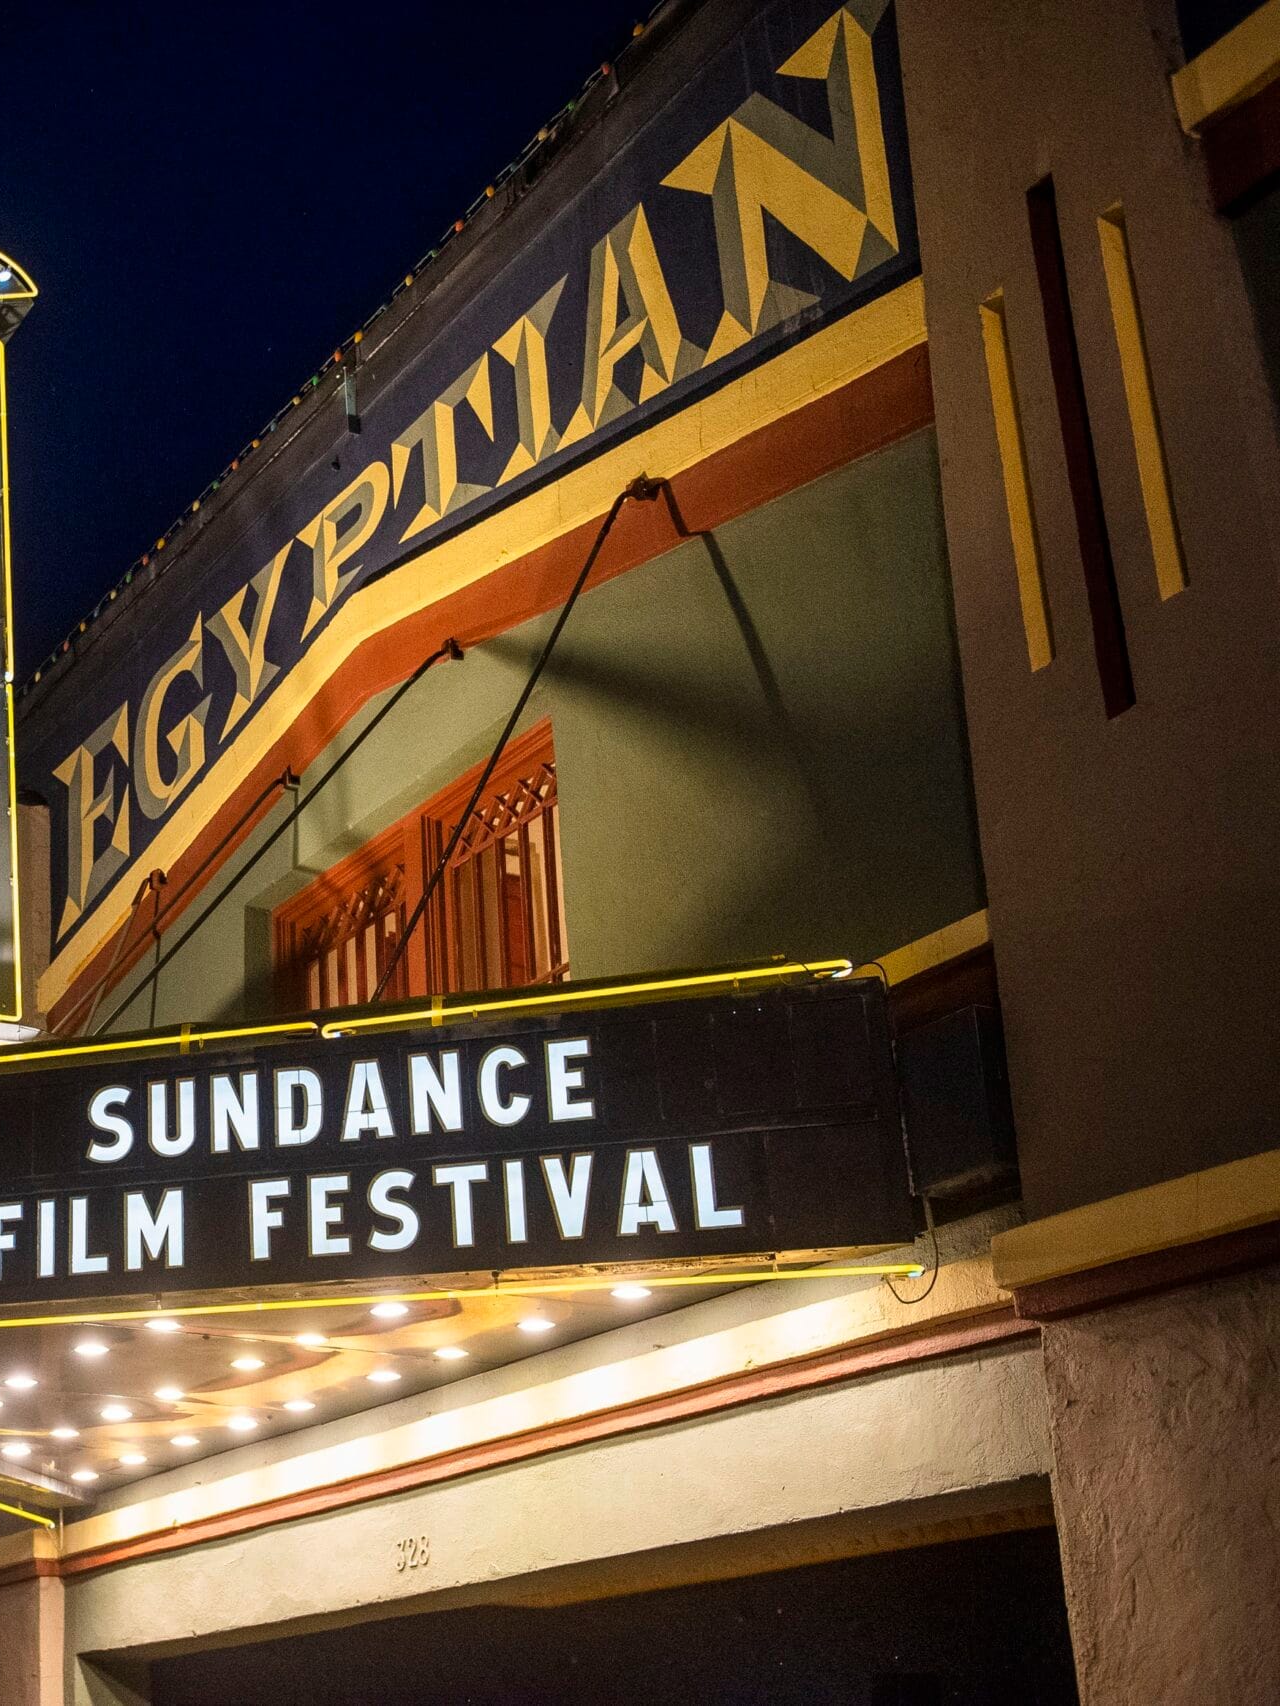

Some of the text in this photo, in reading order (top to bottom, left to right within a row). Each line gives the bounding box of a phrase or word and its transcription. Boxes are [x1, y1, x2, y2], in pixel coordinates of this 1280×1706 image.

[51, 0, 900, 944] EGYPTIAN
[85, 1036, 596, 1164] SUNDANCE
[248, 1142, 745, 1263] FESTIVAL
[396, 1535, 431, 1572] 328
